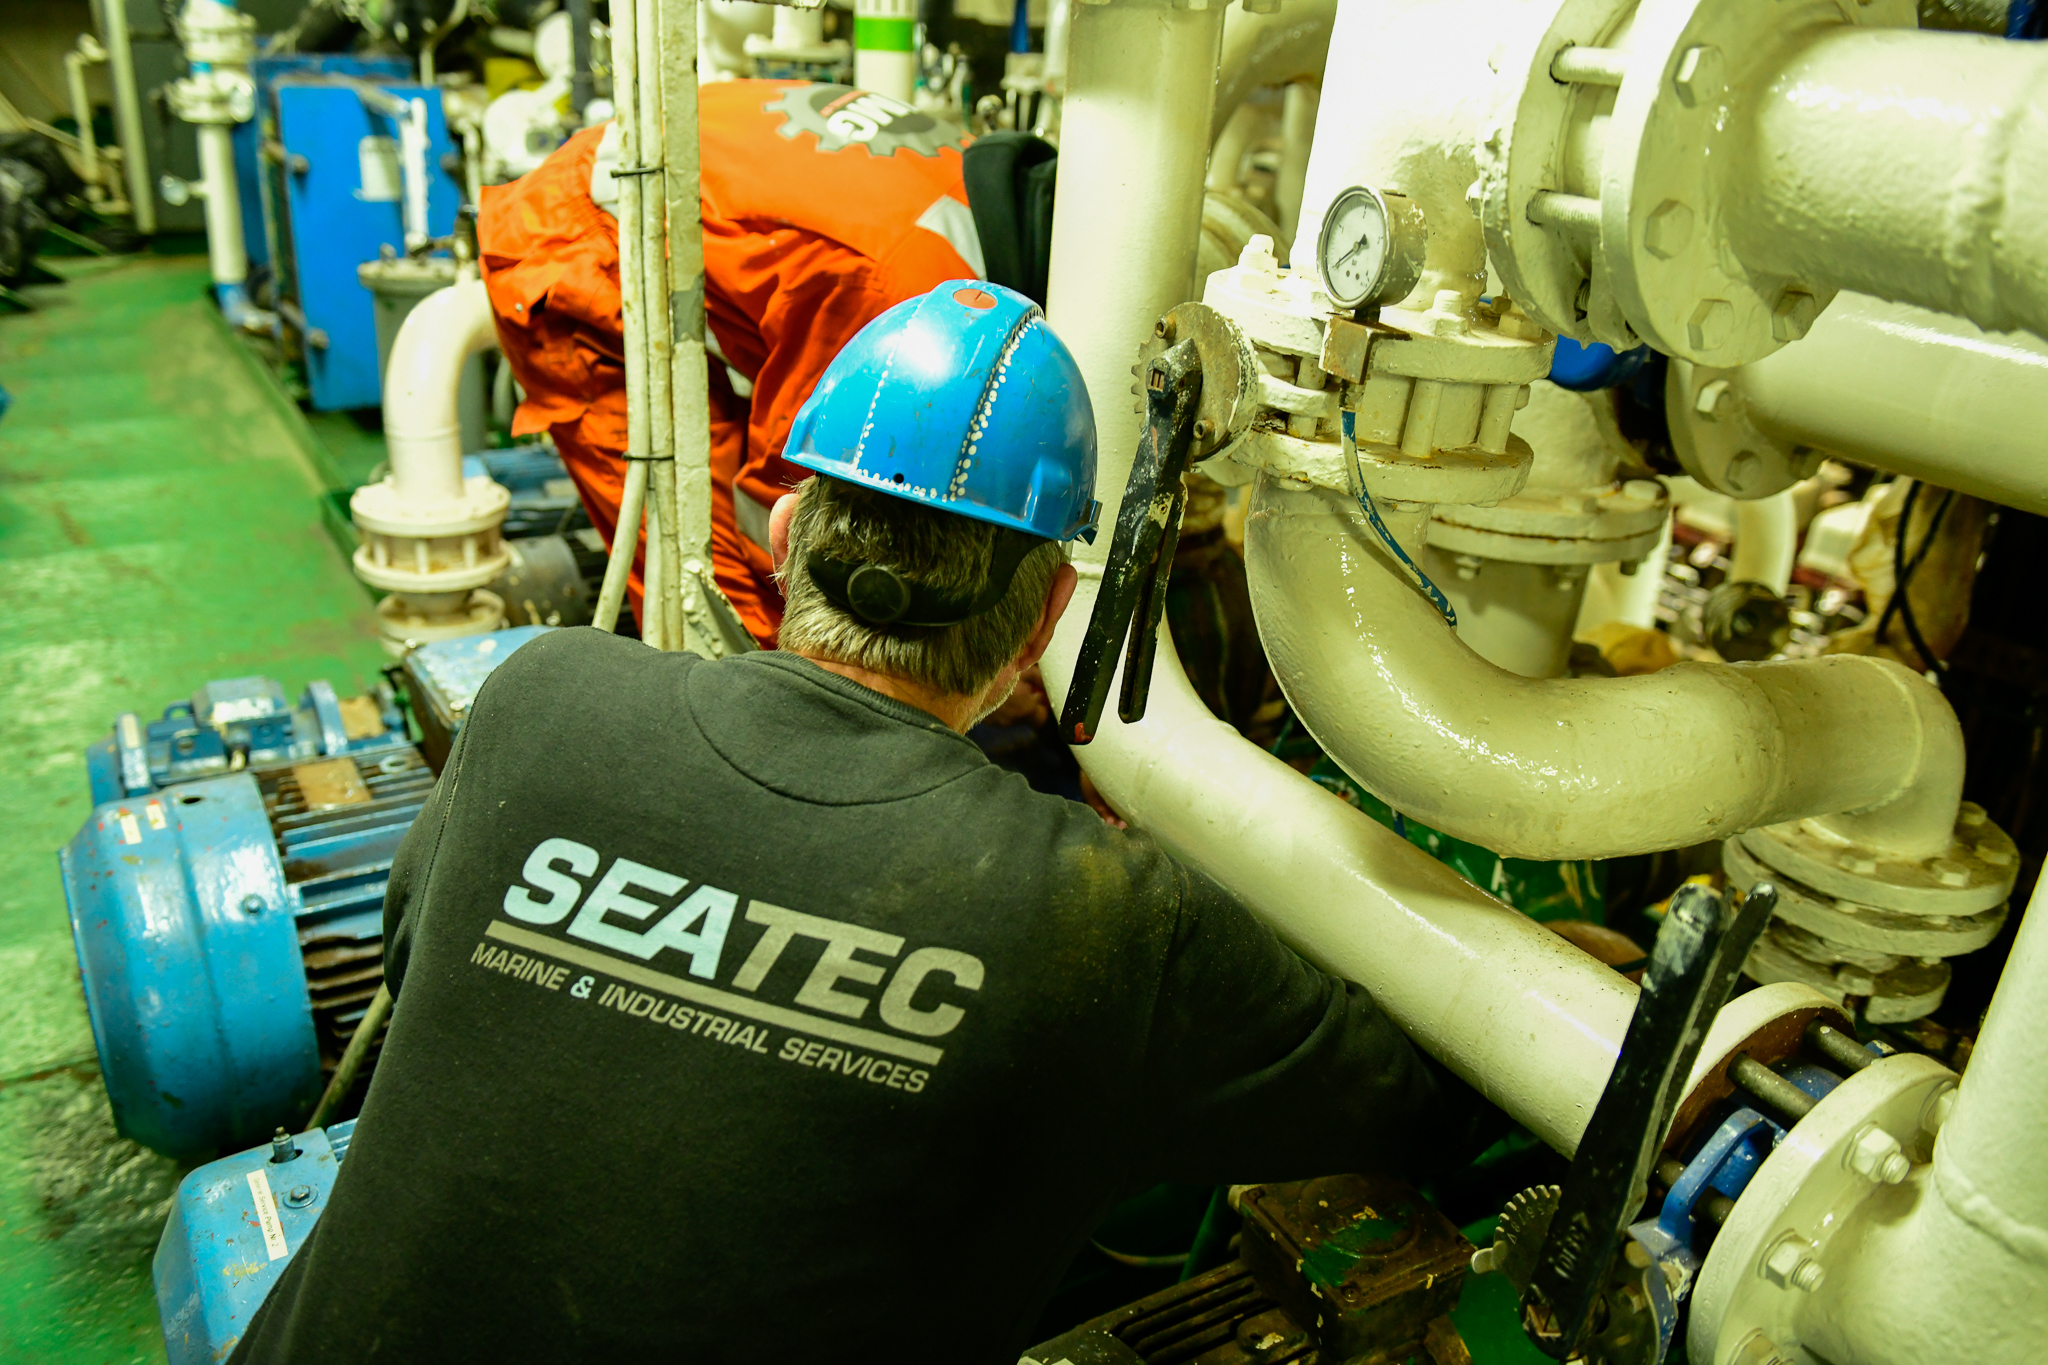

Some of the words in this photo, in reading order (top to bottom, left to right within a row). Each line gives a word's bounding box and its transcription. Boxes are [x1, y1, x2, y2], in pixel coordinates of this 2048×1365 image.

[470, 942, 571, 991] MARINE
[570, 975, 595, 999] &
[598, 983, 769, 1054] INDUSTRIAL
[778, 1037, 930, 1093] SERVICES
[502, 837, 986, 1037] SEATEC
